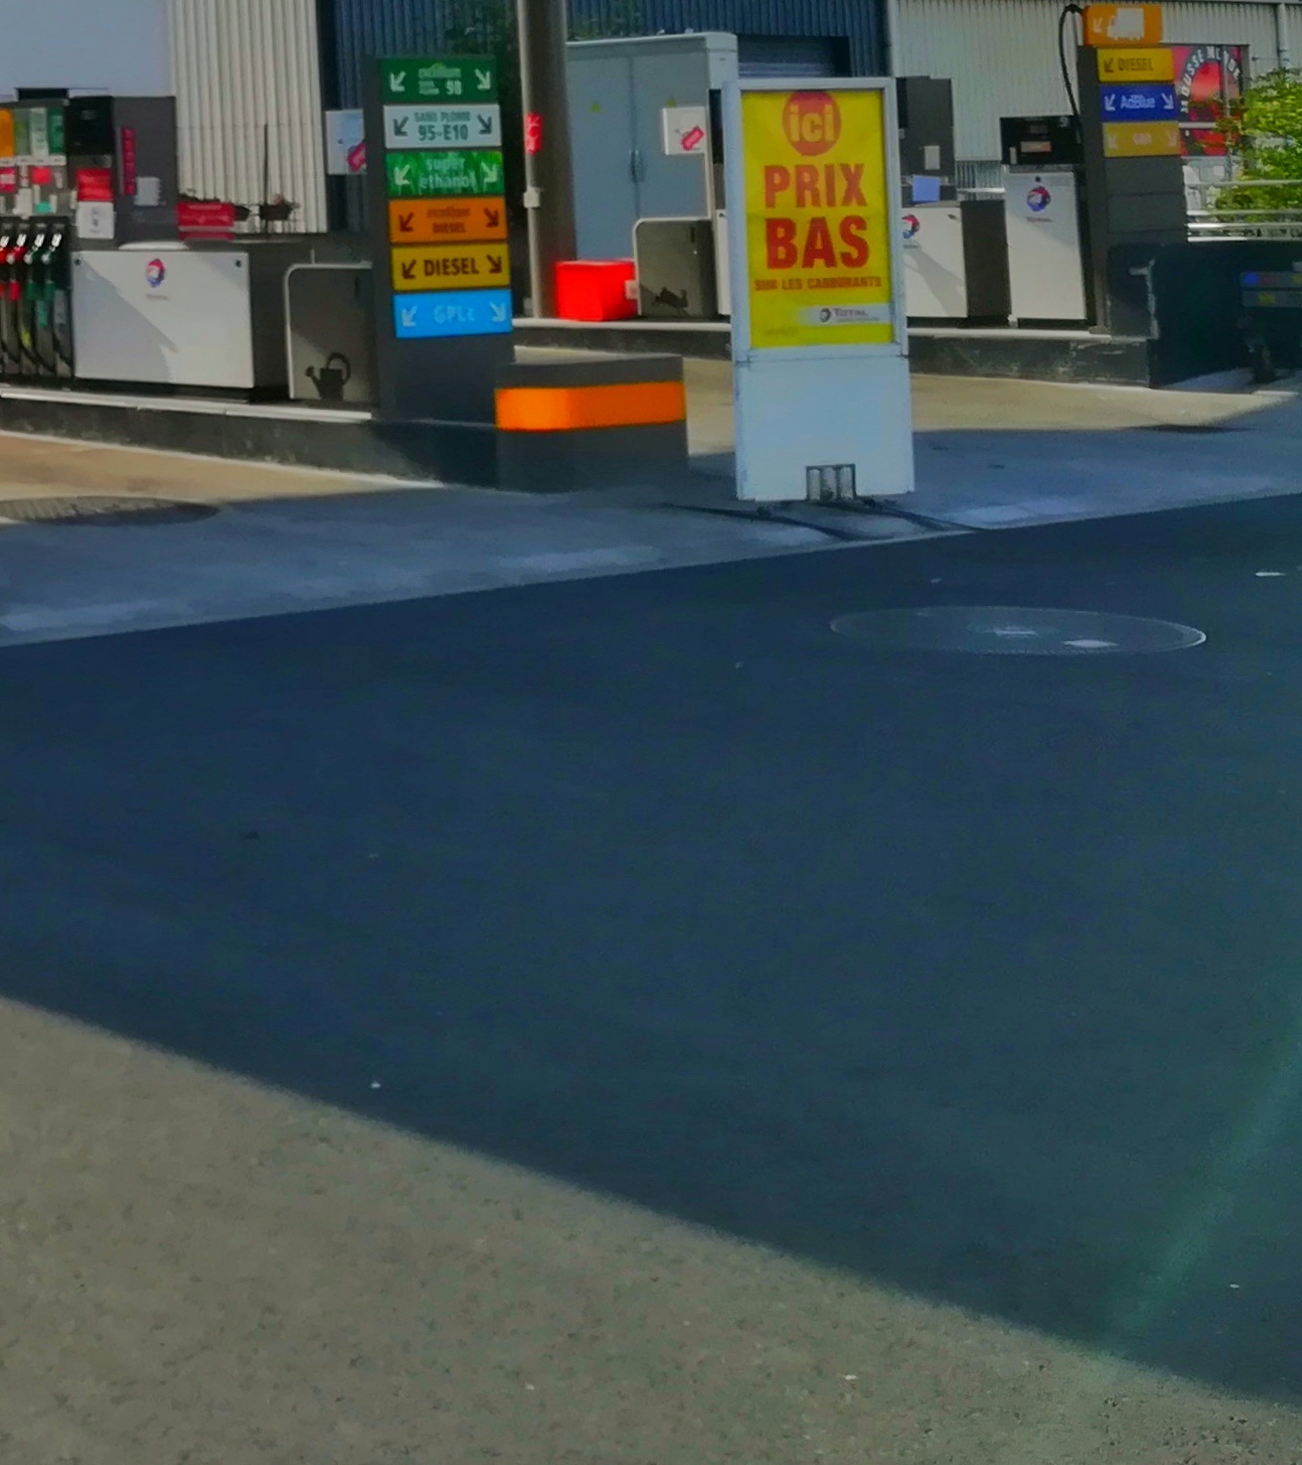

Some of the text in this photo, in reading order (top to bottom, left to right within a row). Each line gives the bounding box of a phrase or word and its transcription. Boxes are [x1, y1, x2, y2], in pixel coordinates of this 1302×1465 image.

[417, 123, 470, 142] 95-E10
[788, 103, 836, 143] ici
[763, 163, 868, 210] PRIX
[764, 215, 871, 270] BAS
[423, 256, 480, 278] DIESEL
